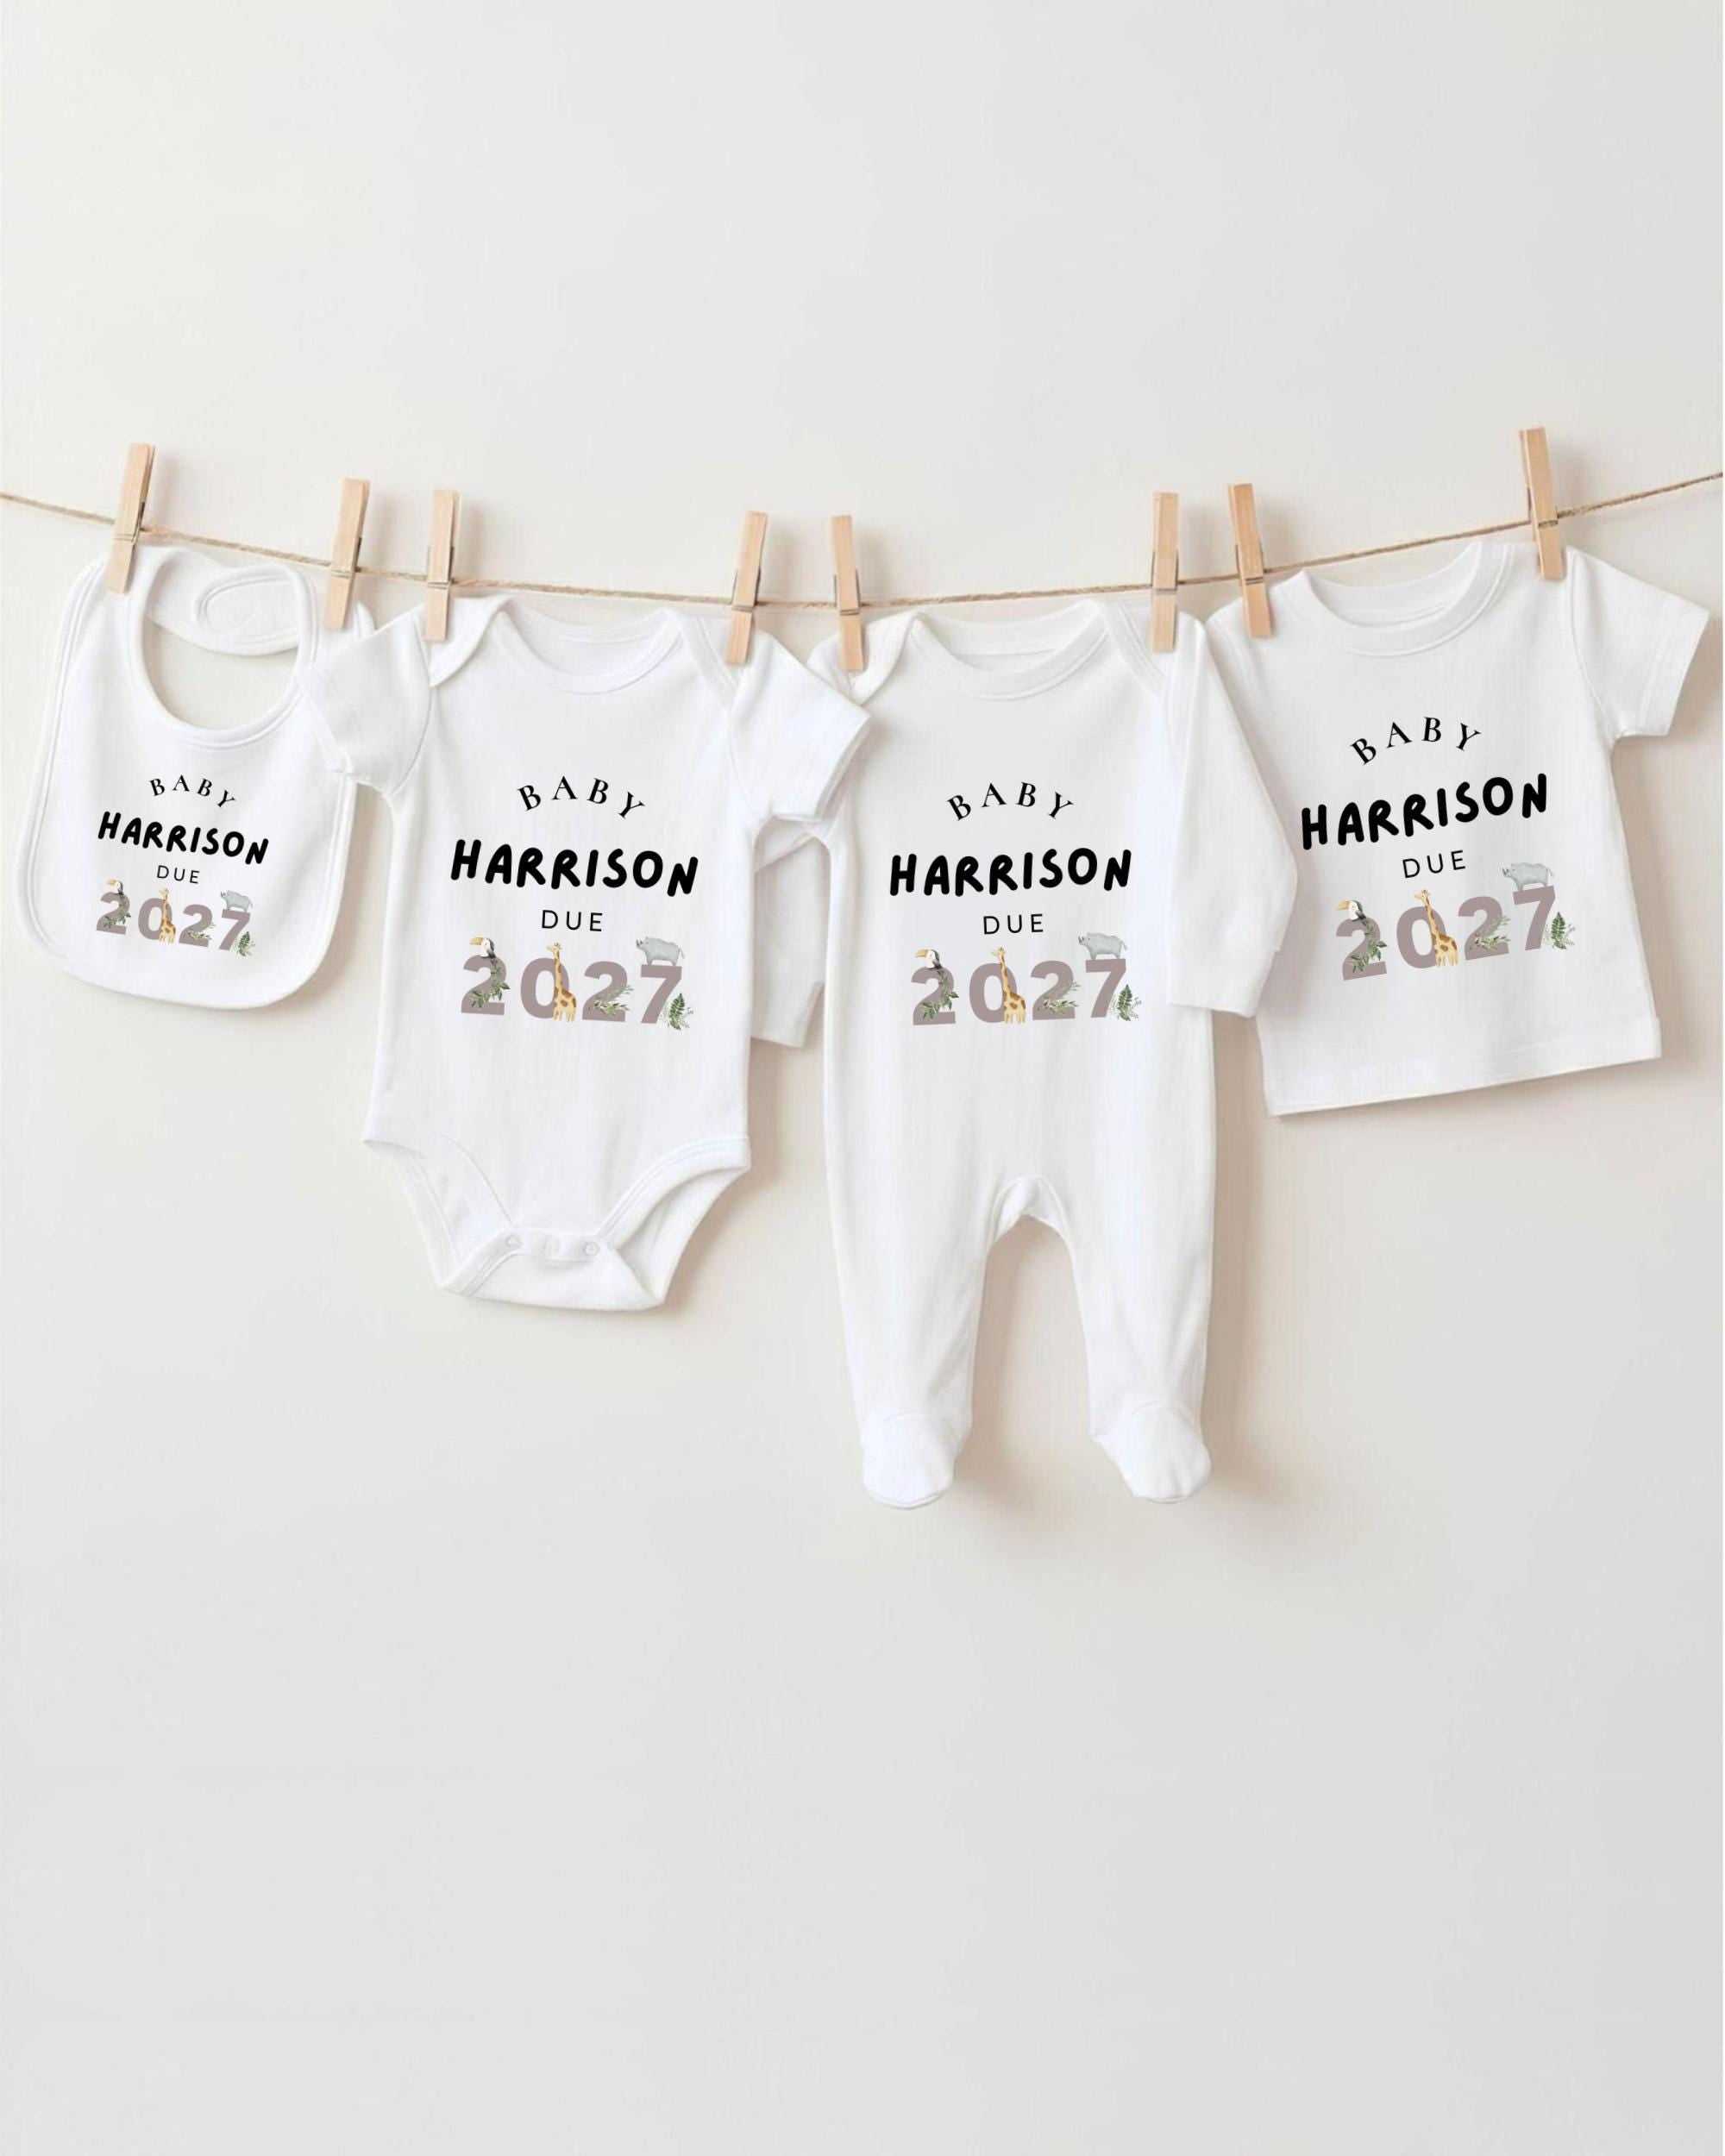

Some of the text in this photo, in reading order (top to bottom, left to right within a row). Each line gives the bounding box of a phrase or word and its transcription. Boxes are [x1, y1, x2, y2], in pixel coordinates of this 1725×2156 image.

[1350, 717, 1483, 765] BABY
[148, 774, 235, 809] BABY
[516, 775, 646, 819] BABY
[947, 780, 1075, 821] BABY
[1301, 773, 1548, 851] HARRISON
[97, 811, 269, 865] HARRISON
[156, 864, 200, 884] DUE
[450, 838, 699, 898] HARRISON
[889, 847, 1133, 898] HARRISON
[1402, 849, 1466, 879] DUE
[96, 891, 251, 951] 2027
[541, 909, 604, 932] DUE
[982, 913, 1044, 935] DUE
[1336, 885, 1556, 981] 2027
[461, 953, 683, 1025] 2027
[911, 957, 1126, 1026] 2027
